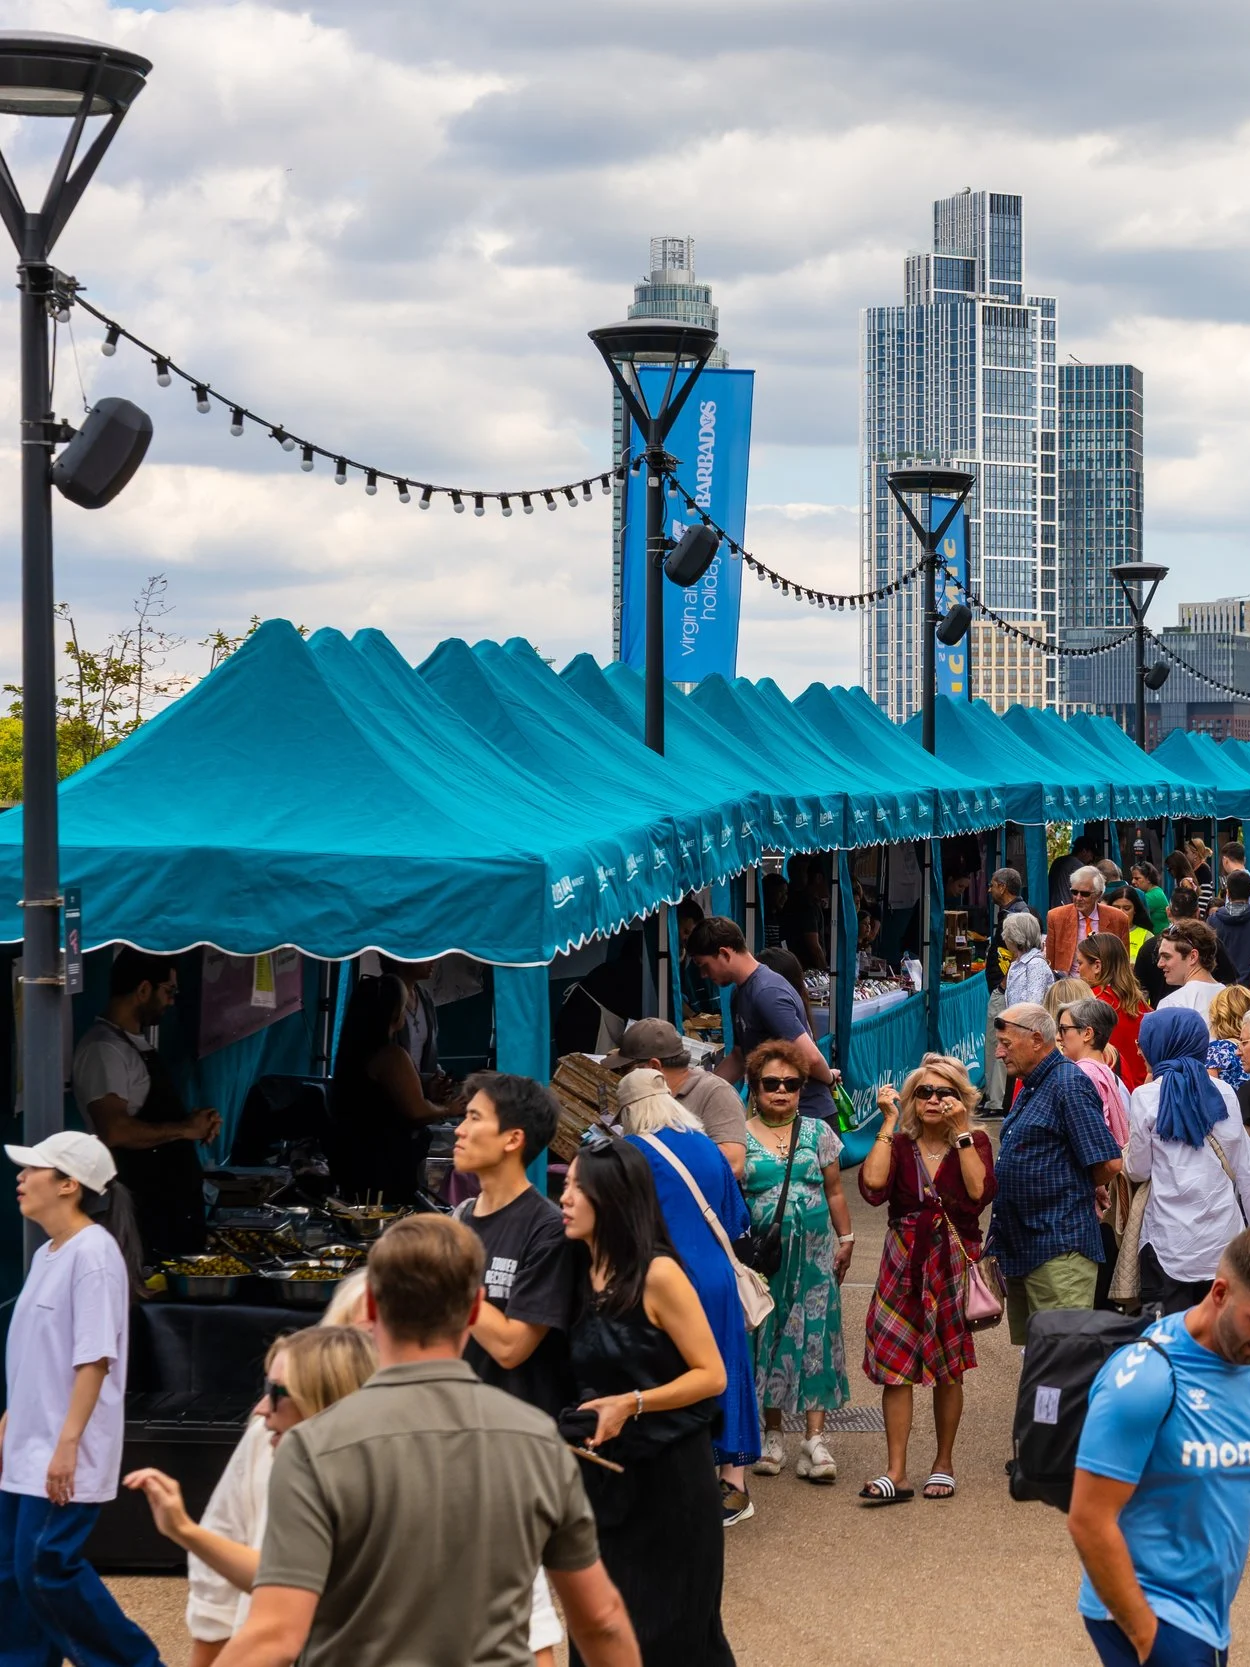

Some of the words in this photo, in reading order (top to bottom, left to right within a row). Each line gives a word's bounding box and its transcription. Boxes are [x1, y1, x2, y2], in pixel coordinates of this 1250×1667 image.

[695, 400, 717, 508] BARBADOS
[700, 546, 721, 620] holiday
[680, 607, 699, 656] virgin
